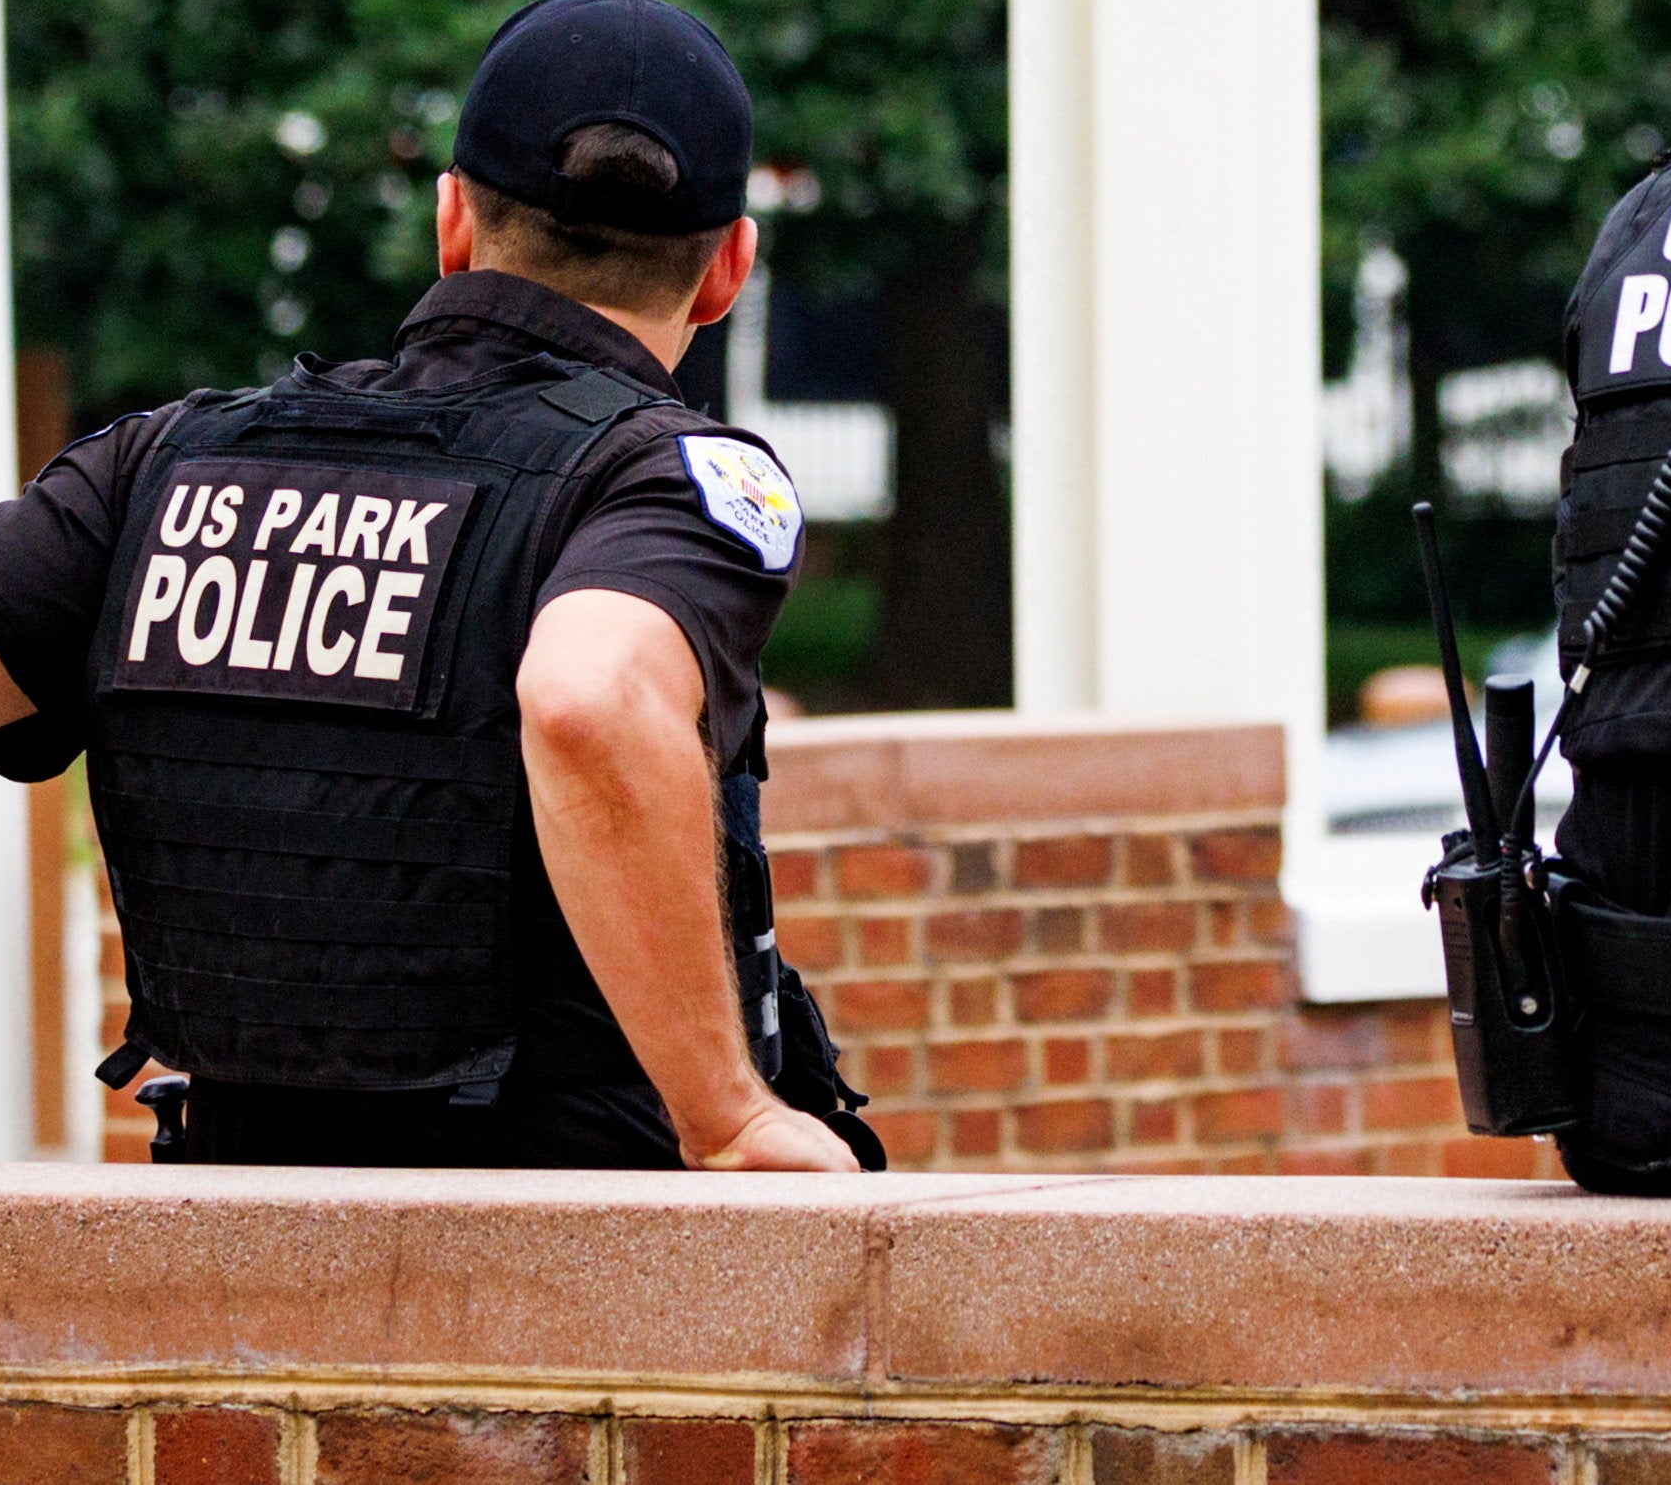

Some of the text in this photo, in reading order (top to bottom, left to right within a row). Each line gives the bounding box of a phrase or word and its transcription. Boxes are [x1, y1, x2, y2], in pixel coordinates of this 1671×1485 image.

[160, 484, 449, 565] US PARK
[128, 554, 425, 681] POLICE
